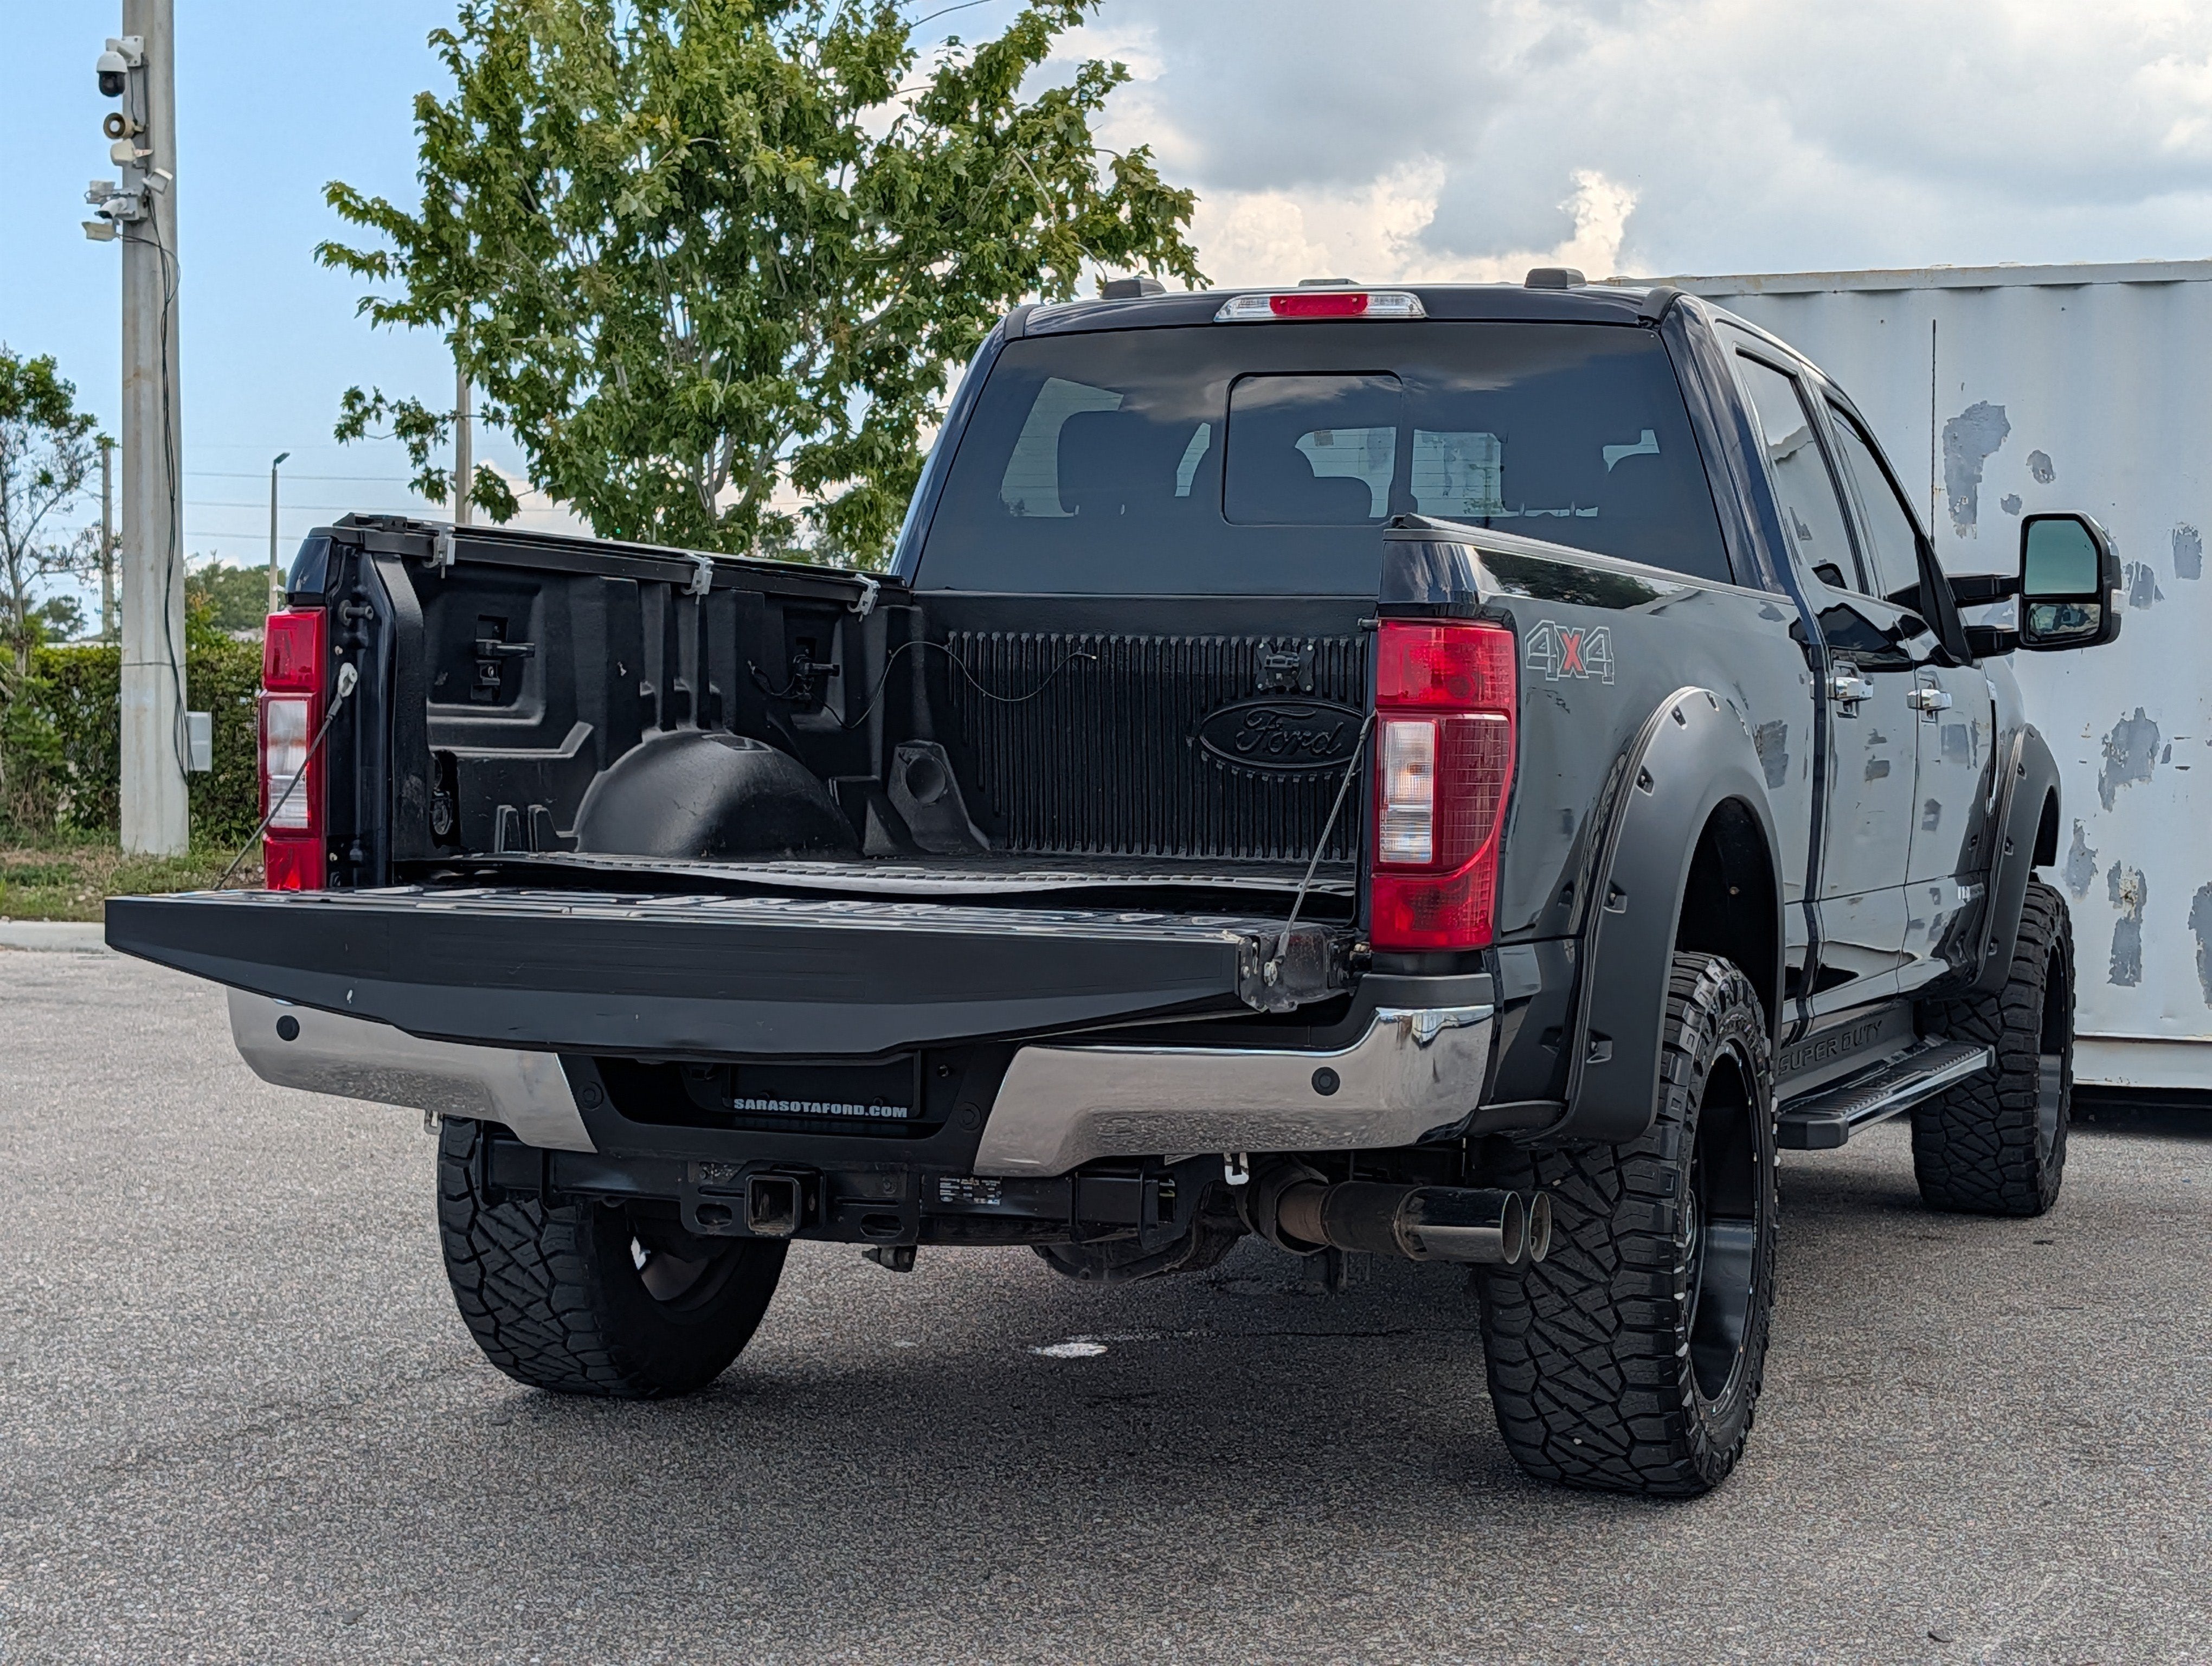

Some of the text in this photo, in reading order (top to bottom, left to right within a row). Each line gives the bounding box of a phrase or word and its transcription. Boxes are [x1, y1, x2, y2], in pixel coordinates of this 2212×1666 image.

[1236, 707, 1344, 755] Ford
[1778, 1020, 1882, 1076] SUPER DUTY
[734, 1098, 908, 1118] SARASOTAFORD.COM
